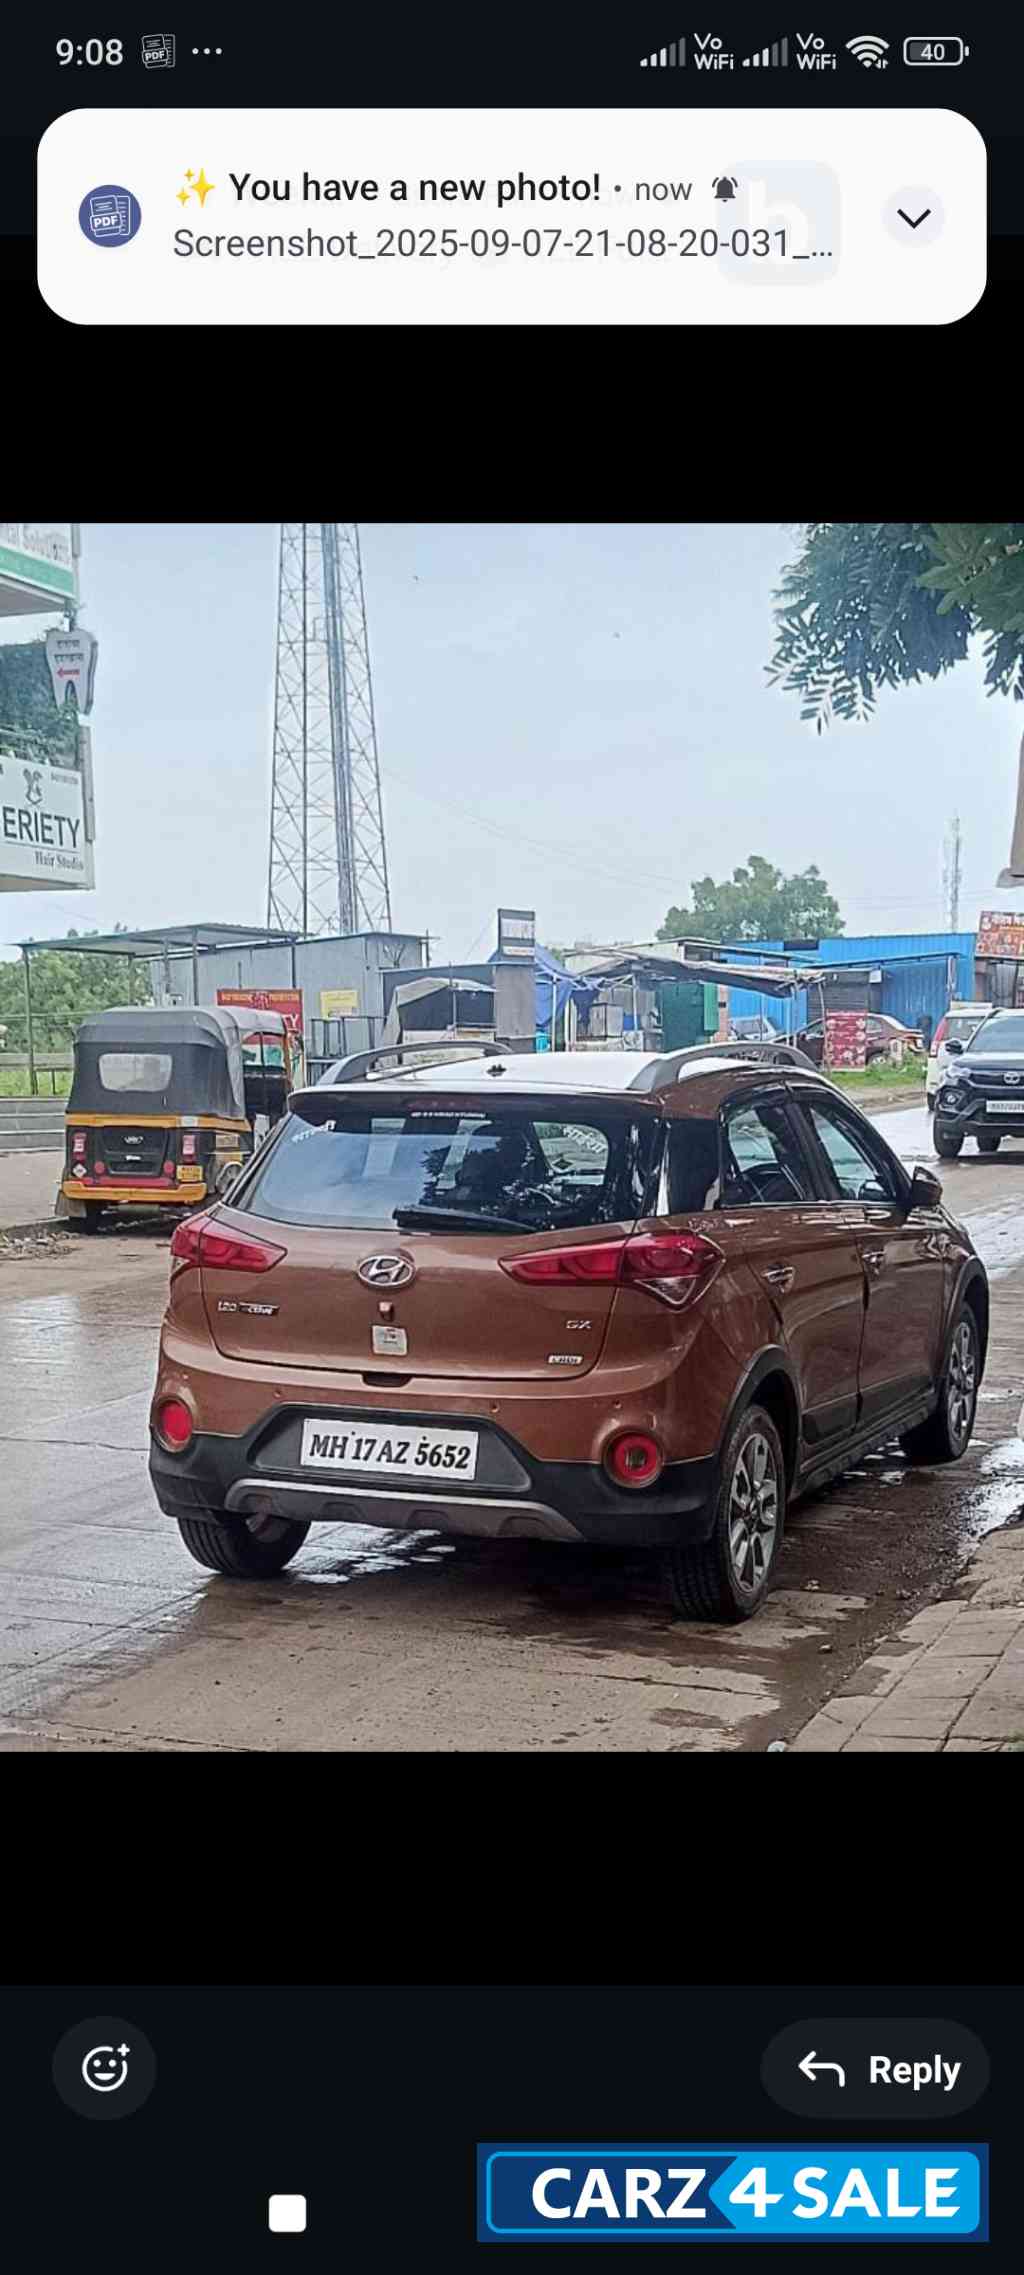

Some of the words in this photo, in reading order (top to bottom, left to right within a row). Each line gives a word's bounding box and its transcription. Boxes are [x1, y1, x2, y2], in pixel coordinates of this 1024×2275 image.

[693, 32, 722, 50] Vo
[796, 32, 825, 50] Vo
[56, 38, 123, 66] 9:08
[144, 51, 165, 61] PDF
[920, 43, 945, 61] 40
[693, 53, 735, 70] WiFi
[796, 53, 837, 70] WiFi
[228, 173, 291, 201] You
[303, 171, 379, 201] have
[390, 179, 409, 201] a
[419, 179, 486, 201] new
[497, 171, 600, 209] photo!
[635, 182, 693, 201] now
[94, 215, 118, 228] PDF
[309, 1434, 349, 1460] MH
[375, 1439, 410, 1465] AZ
[414, 1442, 471, 1470] 5652
[870, 2054, 962, 2092] Reply
